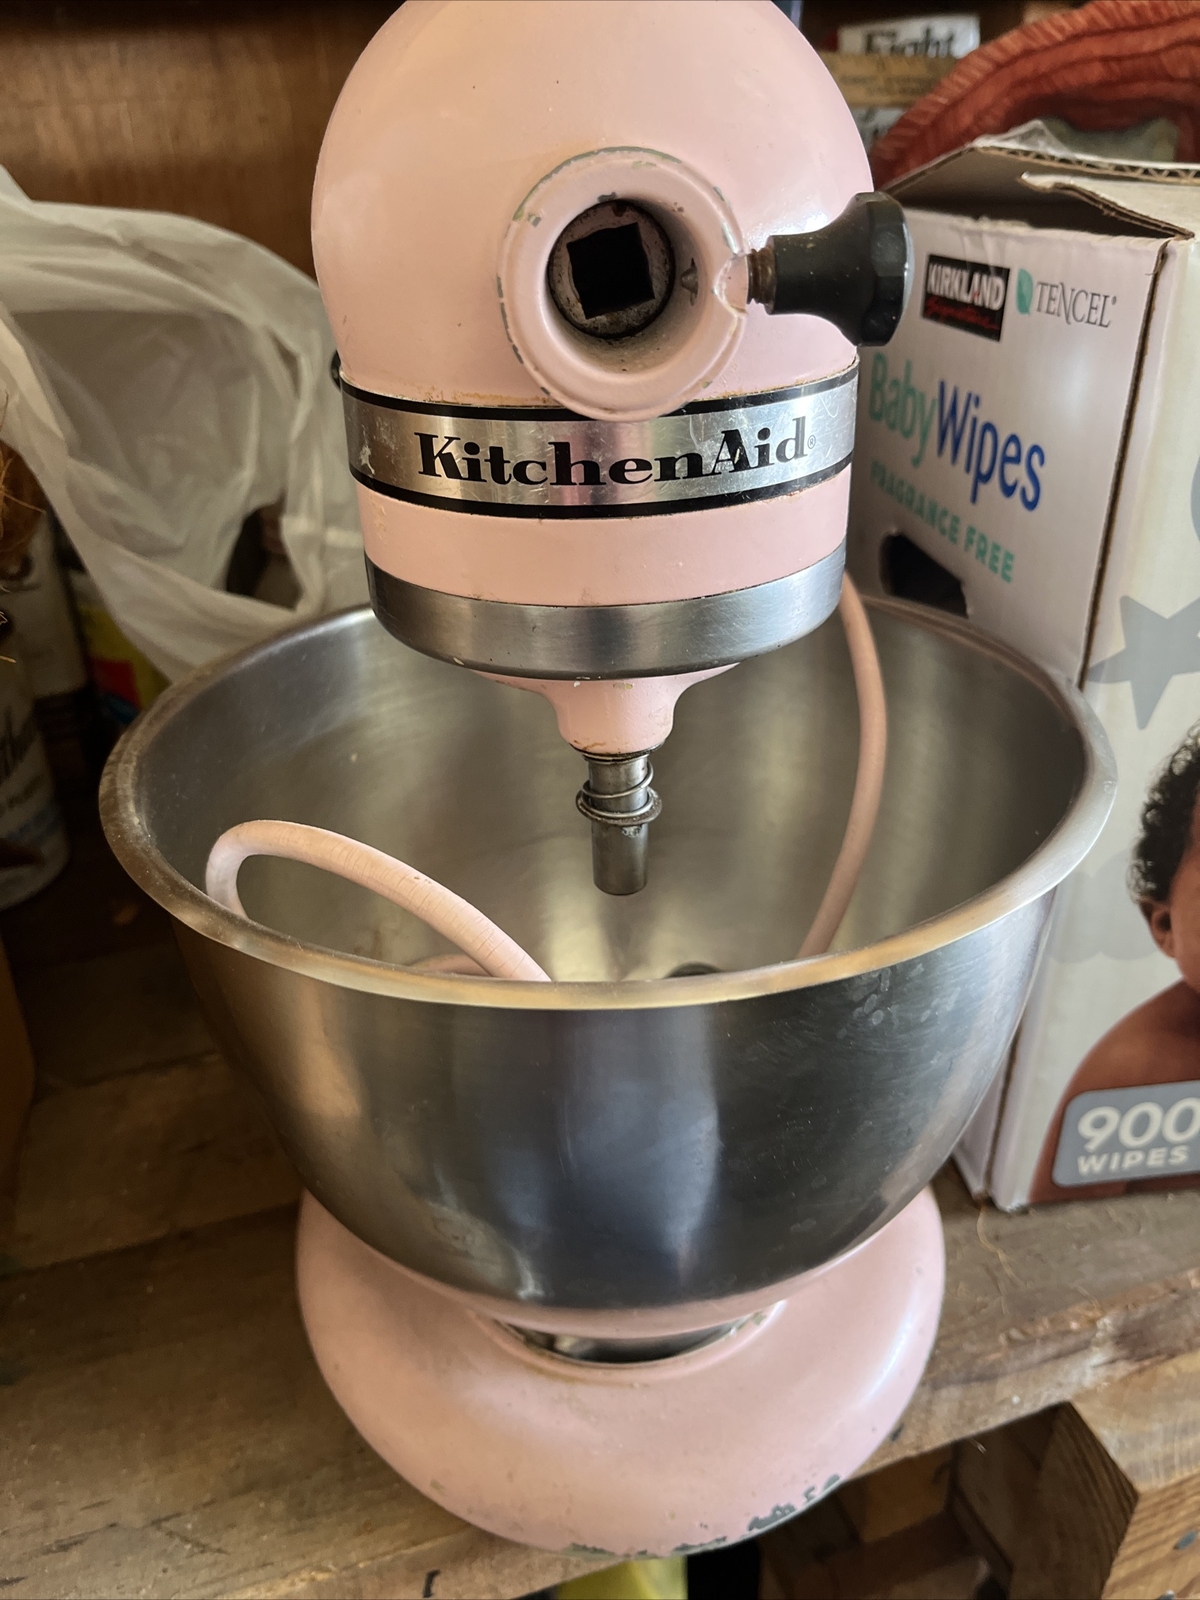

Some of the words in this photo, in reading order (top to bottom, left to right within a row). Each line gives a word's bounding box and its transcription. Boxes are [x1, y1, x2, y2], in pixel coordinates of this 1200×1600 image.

[926, 262, 1006, 312] KIRKLAND
[868, 351, 938, 469] Baby
[937, 379, 1046, 512] Wipes
[869, 459, 962, 545] FRAGRANCE
[963, 525, 1016, 584] FREE
[1077, 1097, 1200, 1153] 900
[1077, 1145, 1190, 1177] WIPES
